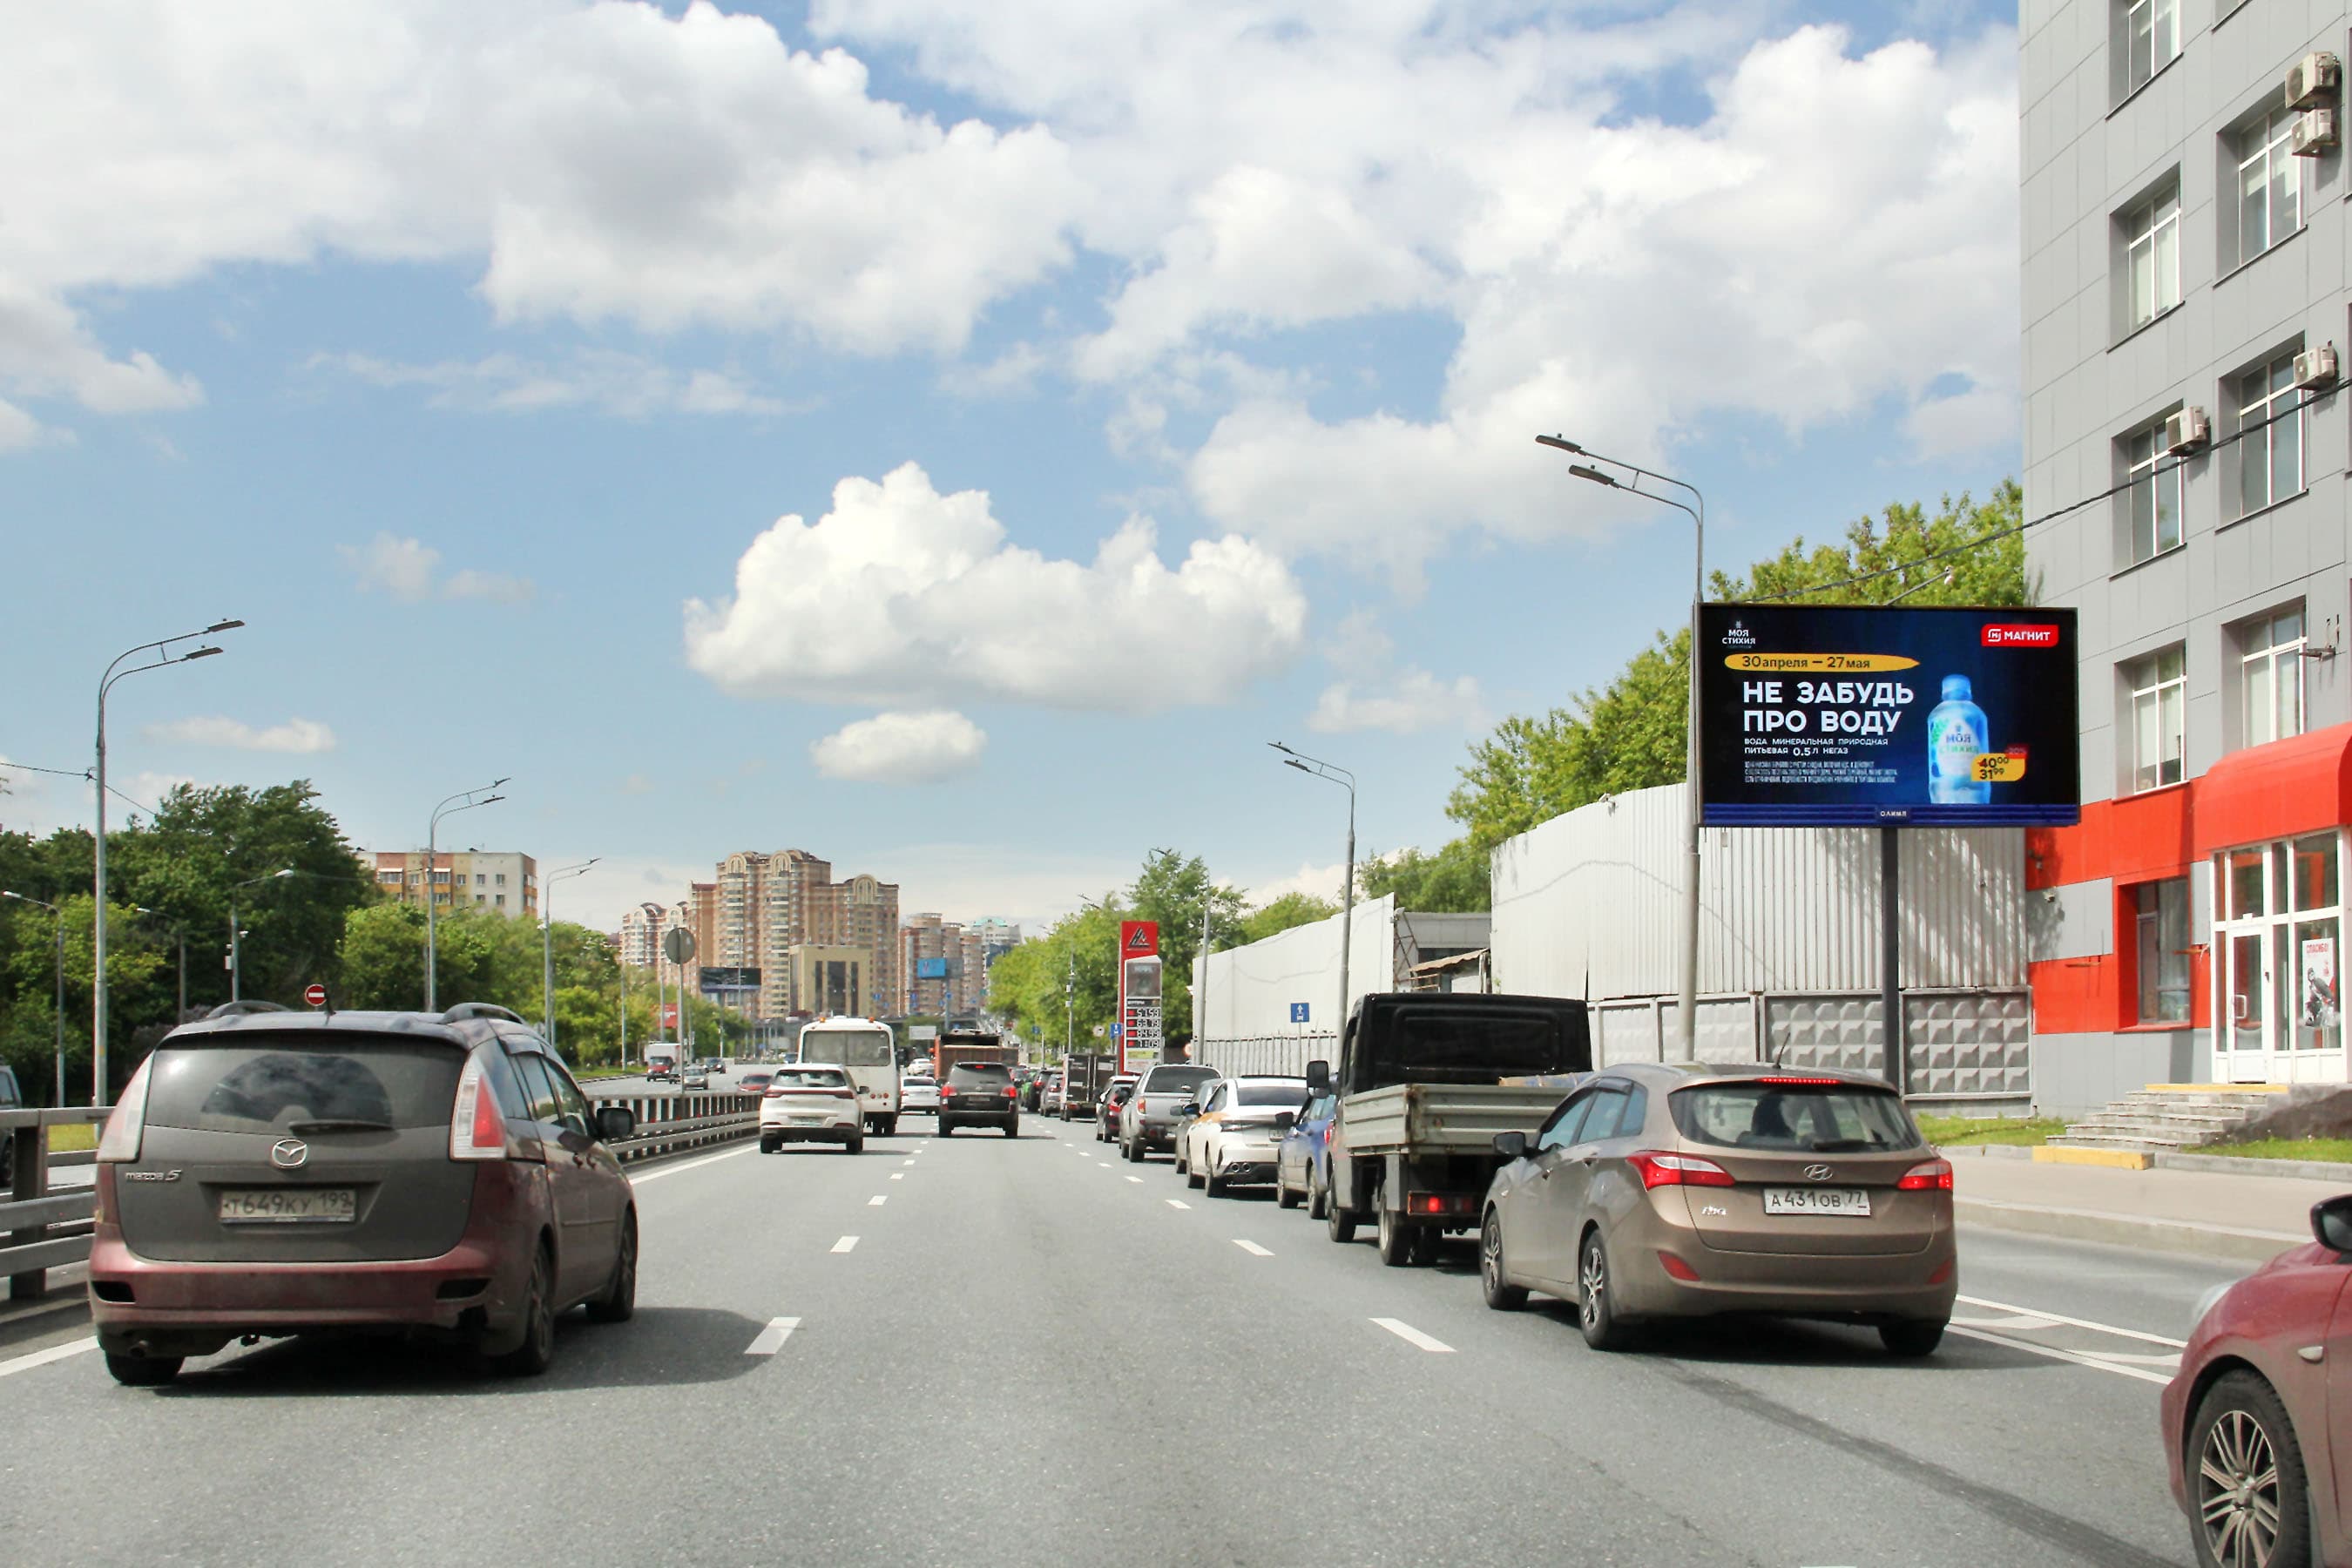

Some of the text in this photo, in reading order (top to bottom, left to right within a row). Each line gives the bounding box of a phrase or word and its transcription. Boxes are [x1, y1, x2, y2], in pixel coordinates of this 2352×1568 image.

[2004, 632, 2051, 641] МАГНИТ
[1846, 659, 1870, 669] мая
[1743, 681, 1915, 707] НЕ ЗАБУДЬ
[1744, 710, 1902, 736] ПРО ВОДУ
[1838, 738, 1889, 747] ПРИРОДНАЯ
